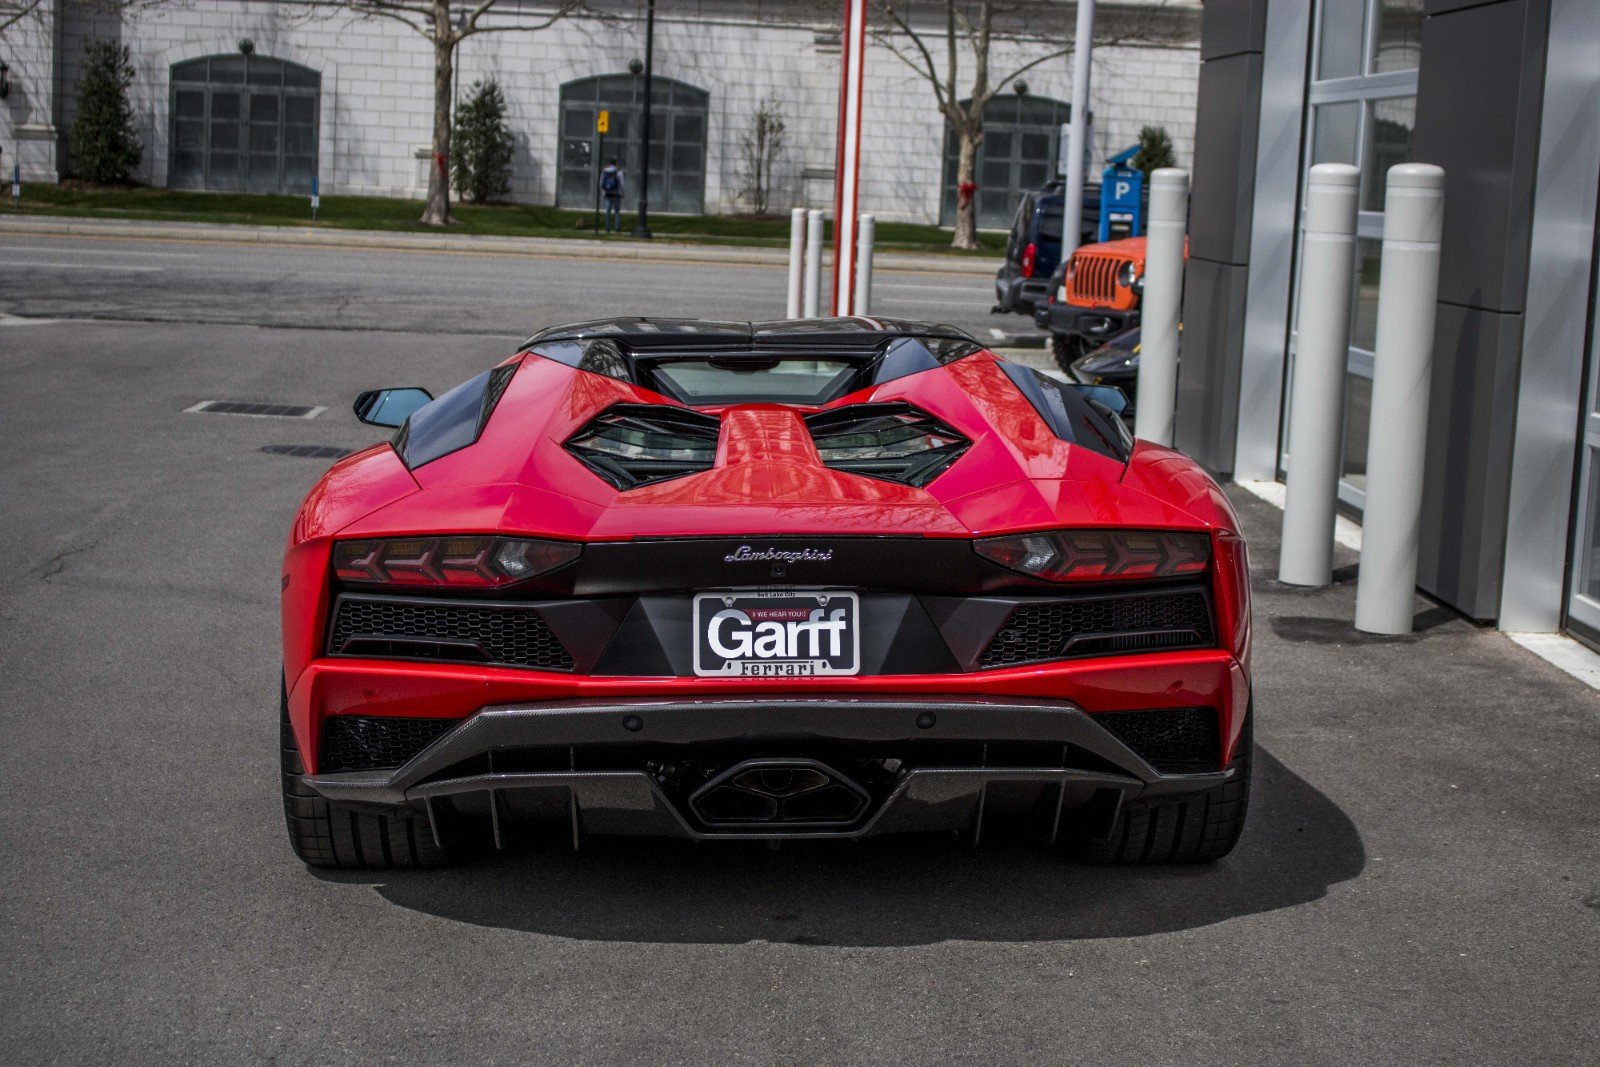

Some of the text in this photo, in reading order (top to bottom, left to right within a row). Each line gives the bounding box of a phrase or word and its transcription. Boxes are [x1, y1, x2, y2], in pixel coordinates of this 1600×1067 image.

[1115, 181, 1130, 200] P
[724, 545, 833, 563] Lamborghini
[707, 608, 847, 659] Garff
[740, 661, 815, 676] Ferrari
